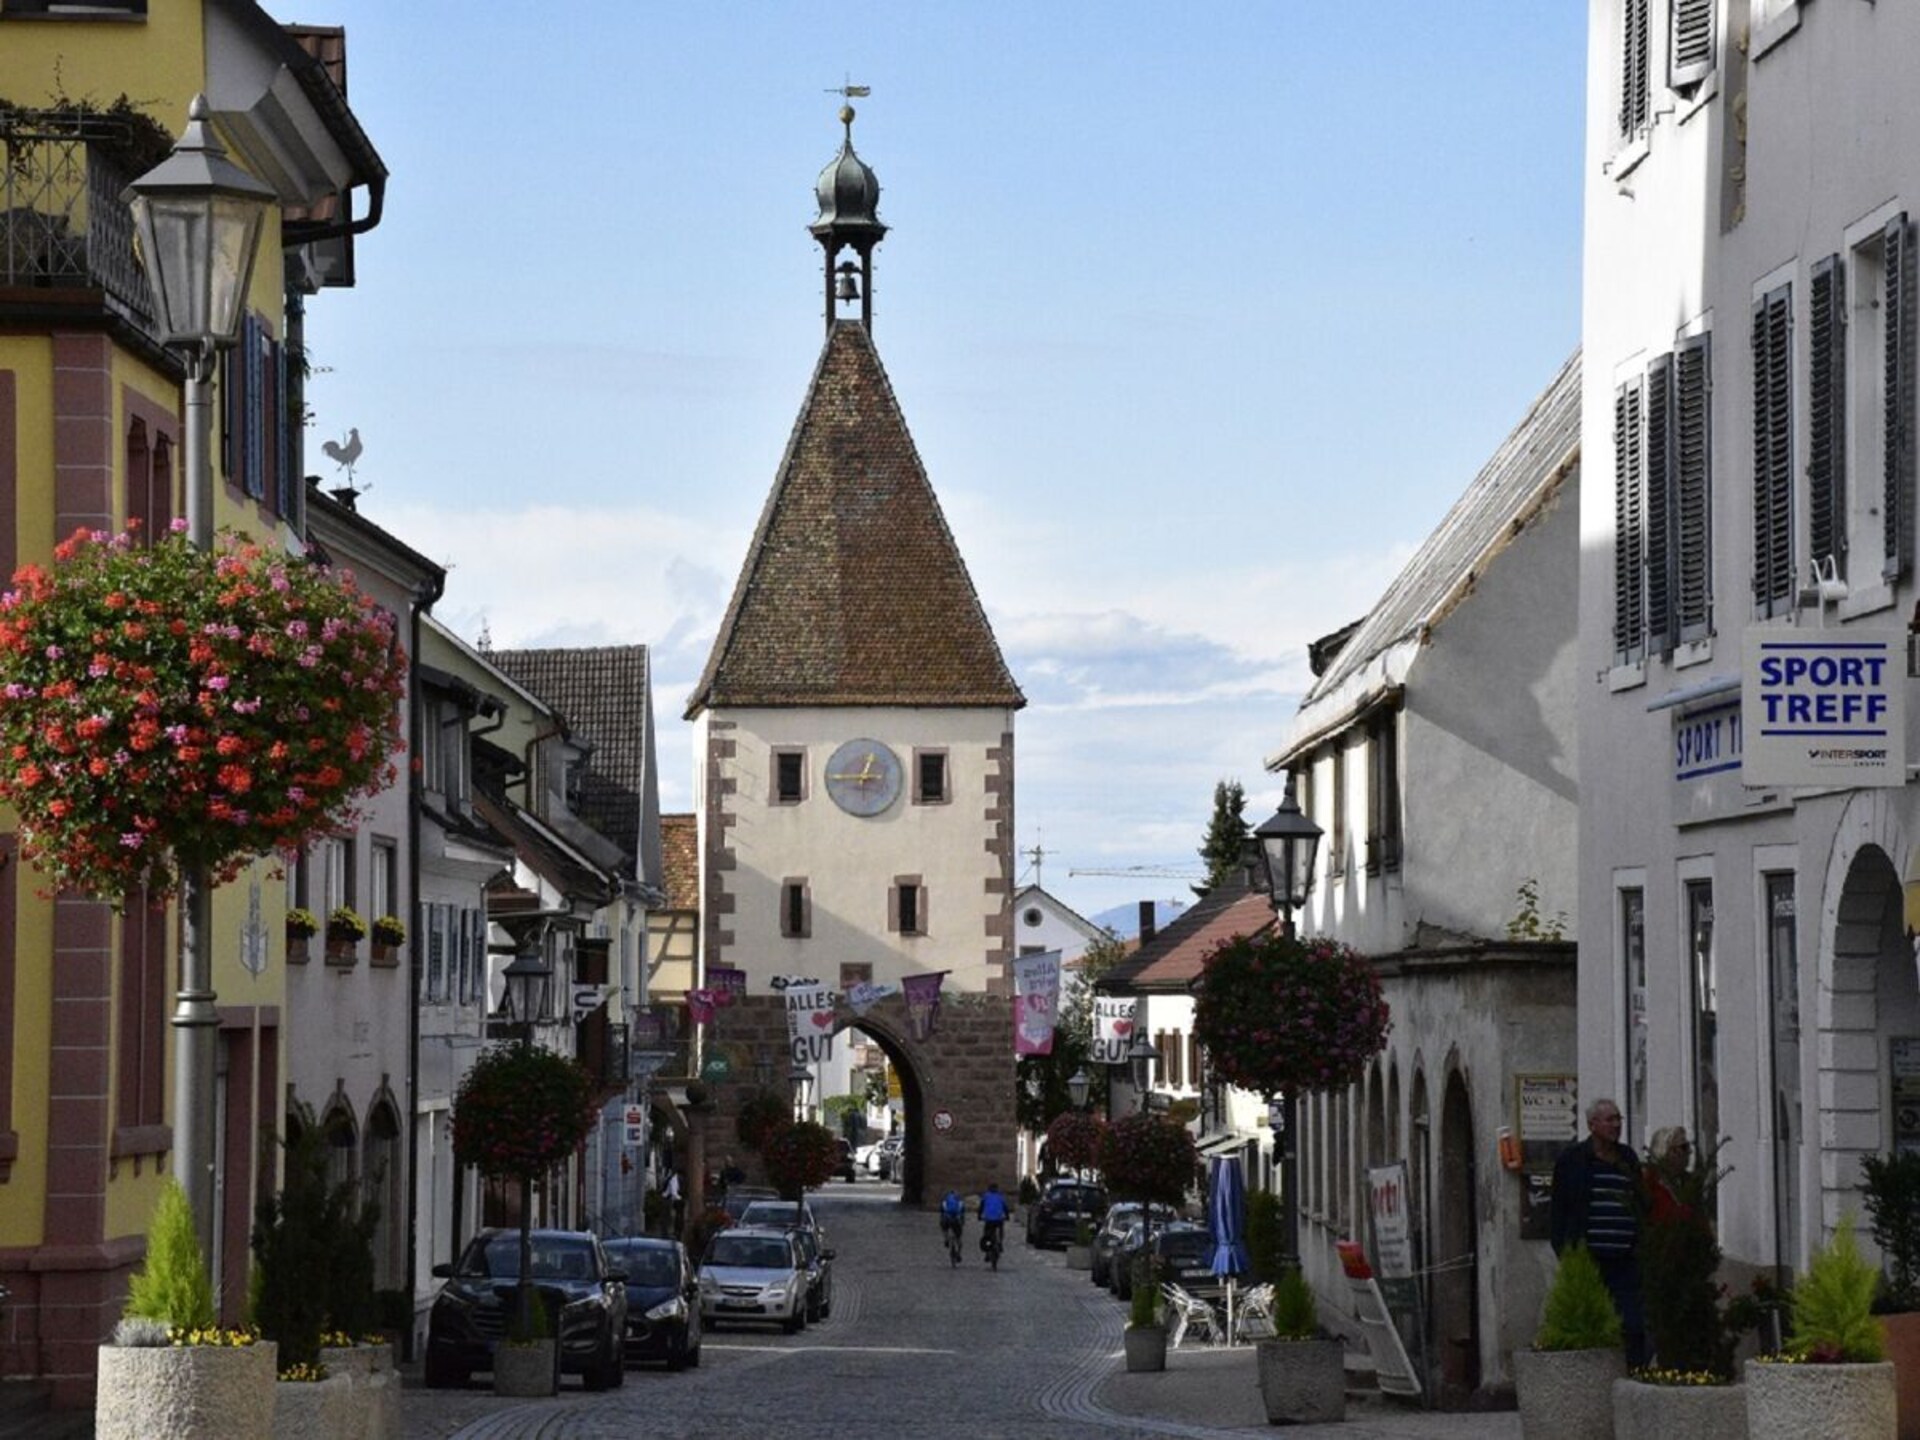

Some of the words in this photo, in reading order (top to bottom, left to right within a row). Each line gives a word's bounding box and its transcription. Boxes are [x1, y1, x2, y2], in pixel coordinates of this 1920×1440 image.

[1761, 656, 1887, 687] SPORT
[1761, 694, 1887, 723] TREFF
[1677, 719, 1721, 767] SPORT
[1820, 749, 1887, 759] INTERSPORT
[789, 991, 835, 1011] ALLES
[1095, 1002, 1136, 1018] ALLES
[793, 1033, 833, 1064] GUT
[1093, 1038, 1133, 1061] GUT
